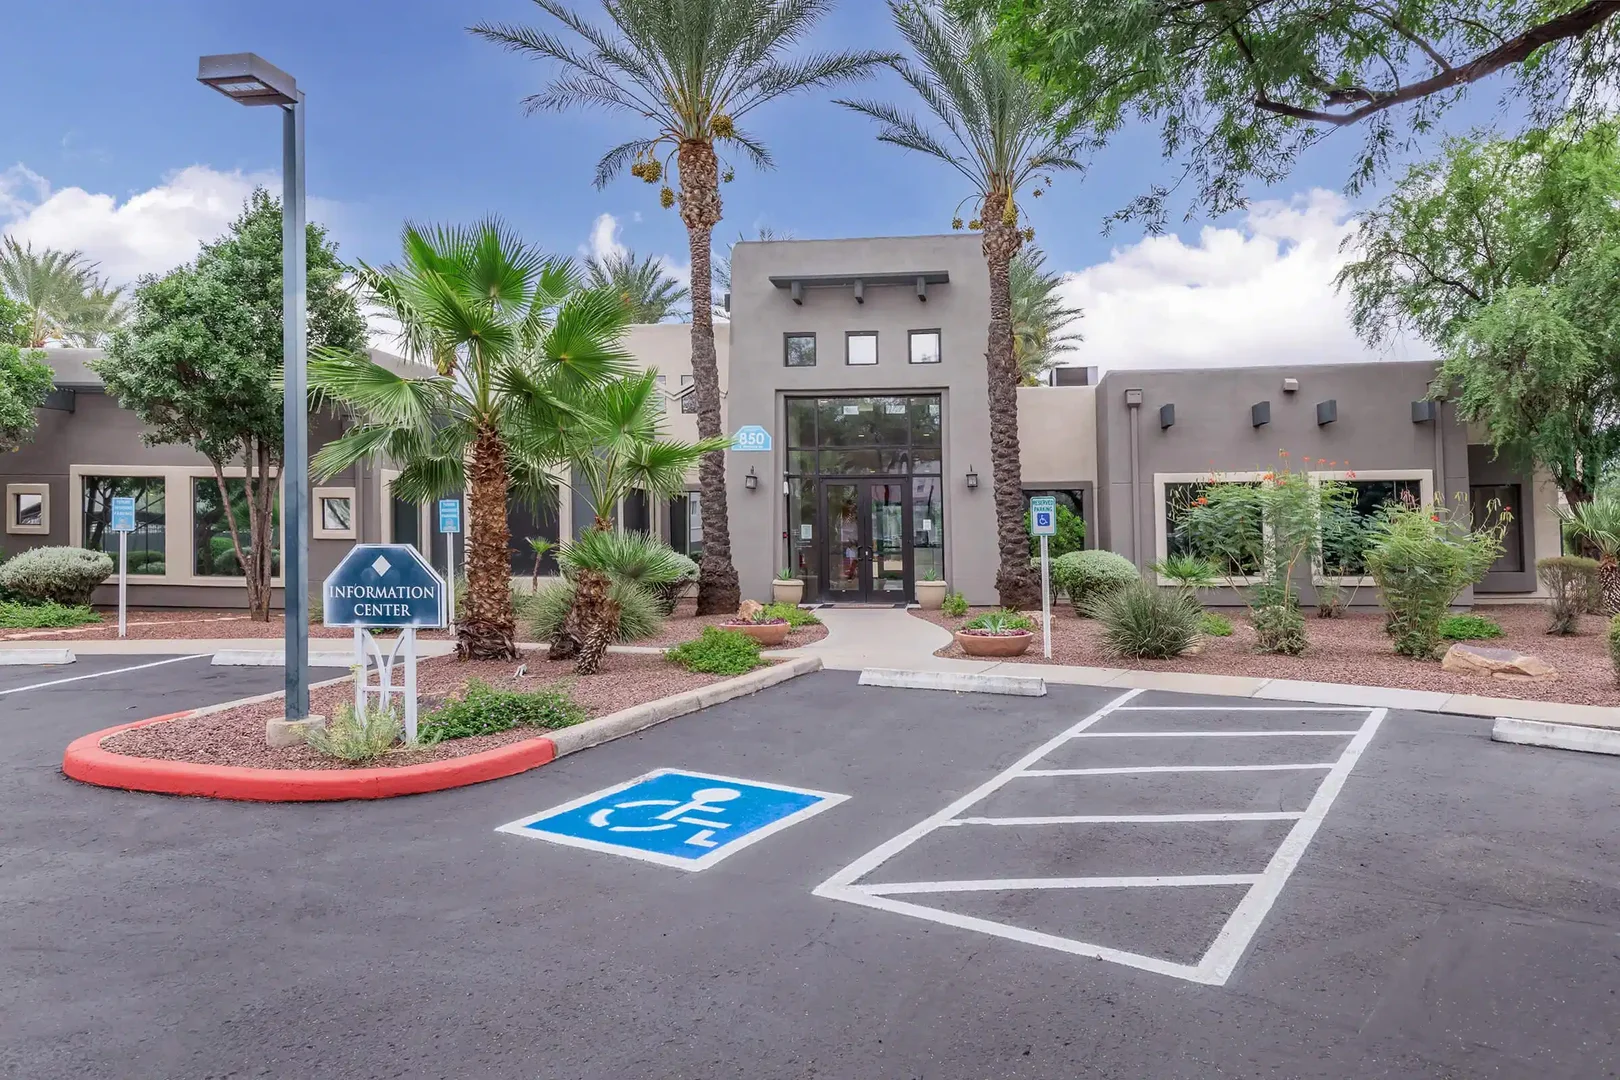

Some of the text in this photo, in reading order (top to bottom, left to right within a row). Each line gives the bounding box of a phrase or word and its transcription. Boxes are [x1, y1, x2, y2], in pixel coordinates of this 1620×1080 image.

[739, 432, 765, 445] 850
[329, 585, 435, 599] INFORMATION
[353, 603, 412, 617] CENTER
